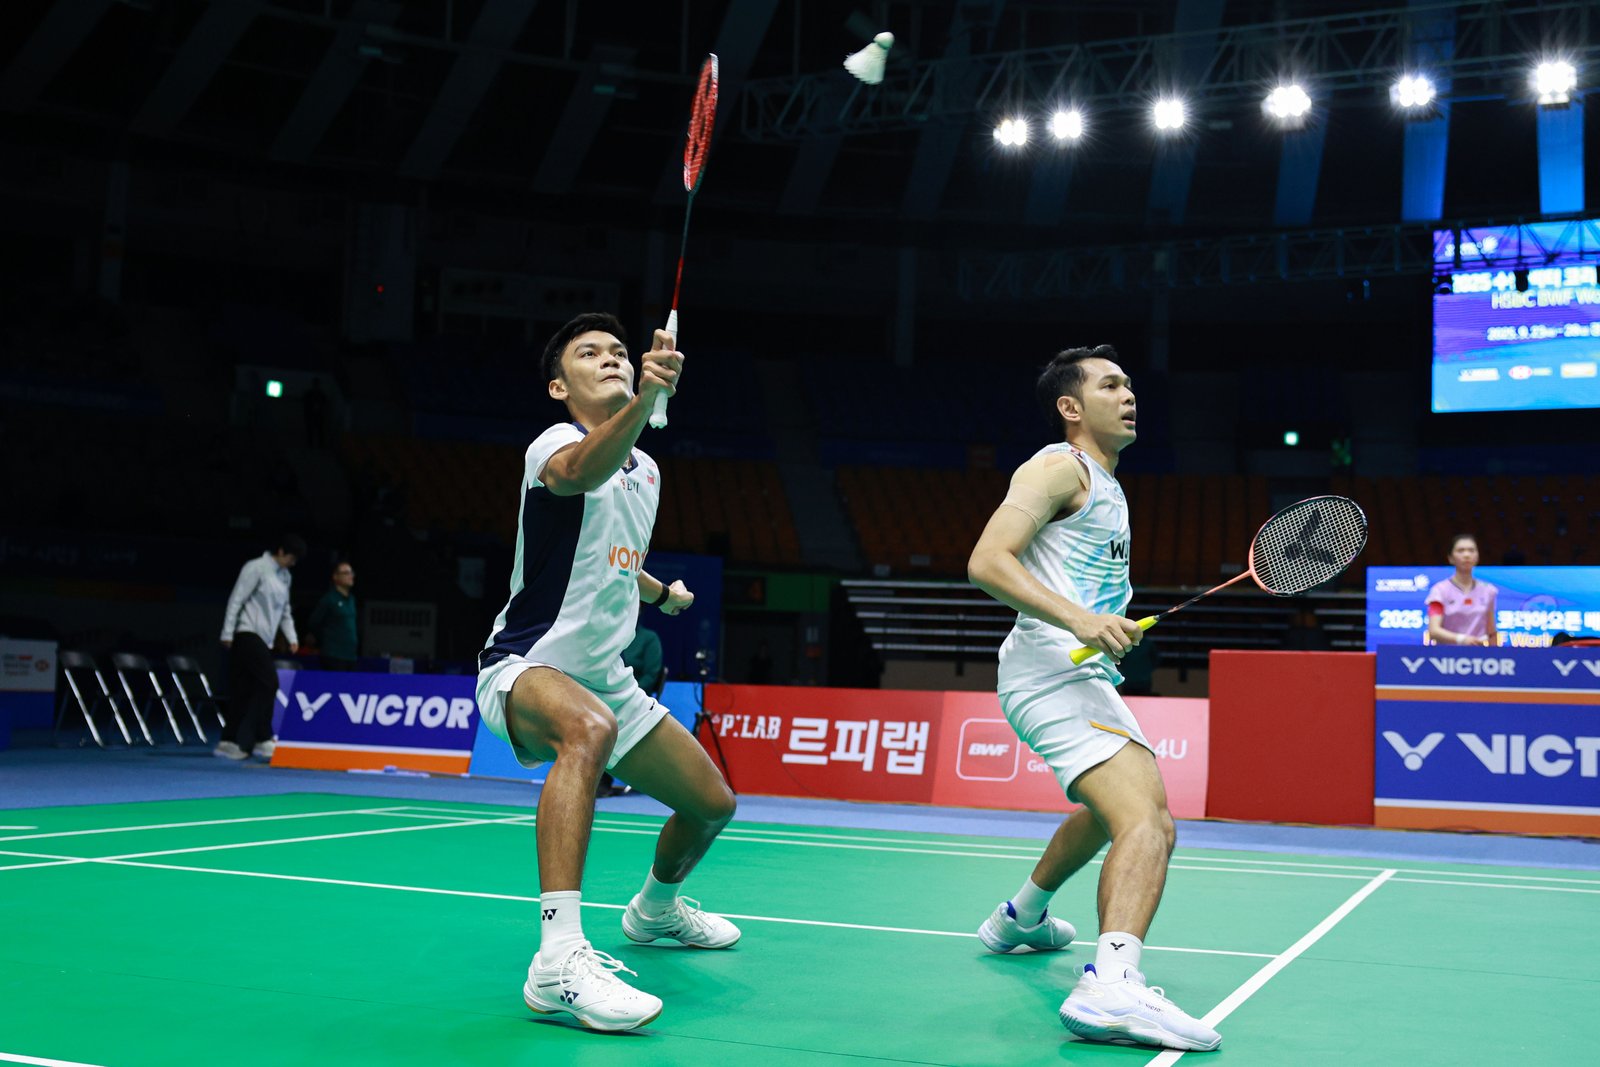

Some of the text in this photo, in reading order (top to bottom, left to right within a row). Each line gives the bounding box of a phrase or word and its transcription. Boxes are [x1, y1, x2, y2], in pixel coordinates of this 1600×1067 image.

[1491, 289, 1536, 309] HSBC
[1379, 610, 1423, 628] 2025
[1429, 657, 1516, 676] VICTOR
[338, 693, 475, 729] VICTOR
[781, 717, 930, 775] 르피랩
[968, 742, 1009, 756] BWF
